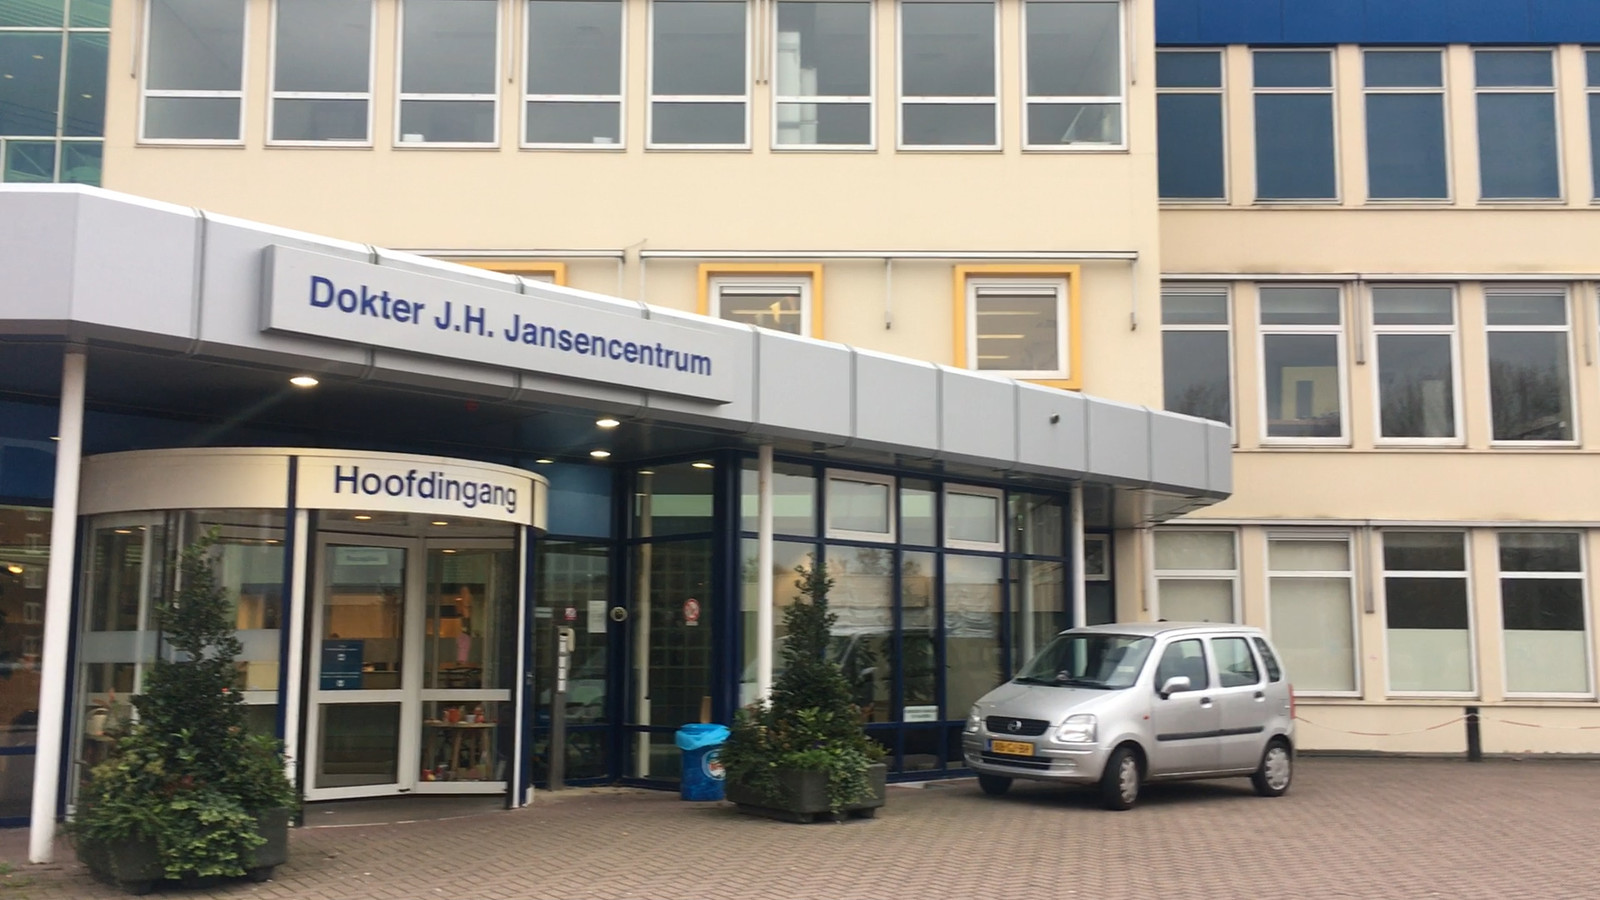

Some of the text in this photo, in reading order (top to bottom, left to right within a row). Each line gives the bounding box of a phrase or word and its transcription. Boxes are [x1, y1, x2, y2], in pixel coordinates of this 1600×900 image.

[310, 275, 712, 376] Dokter J.H. Jansencentrum
[334, 465, 517, 514] Hoofdingang
